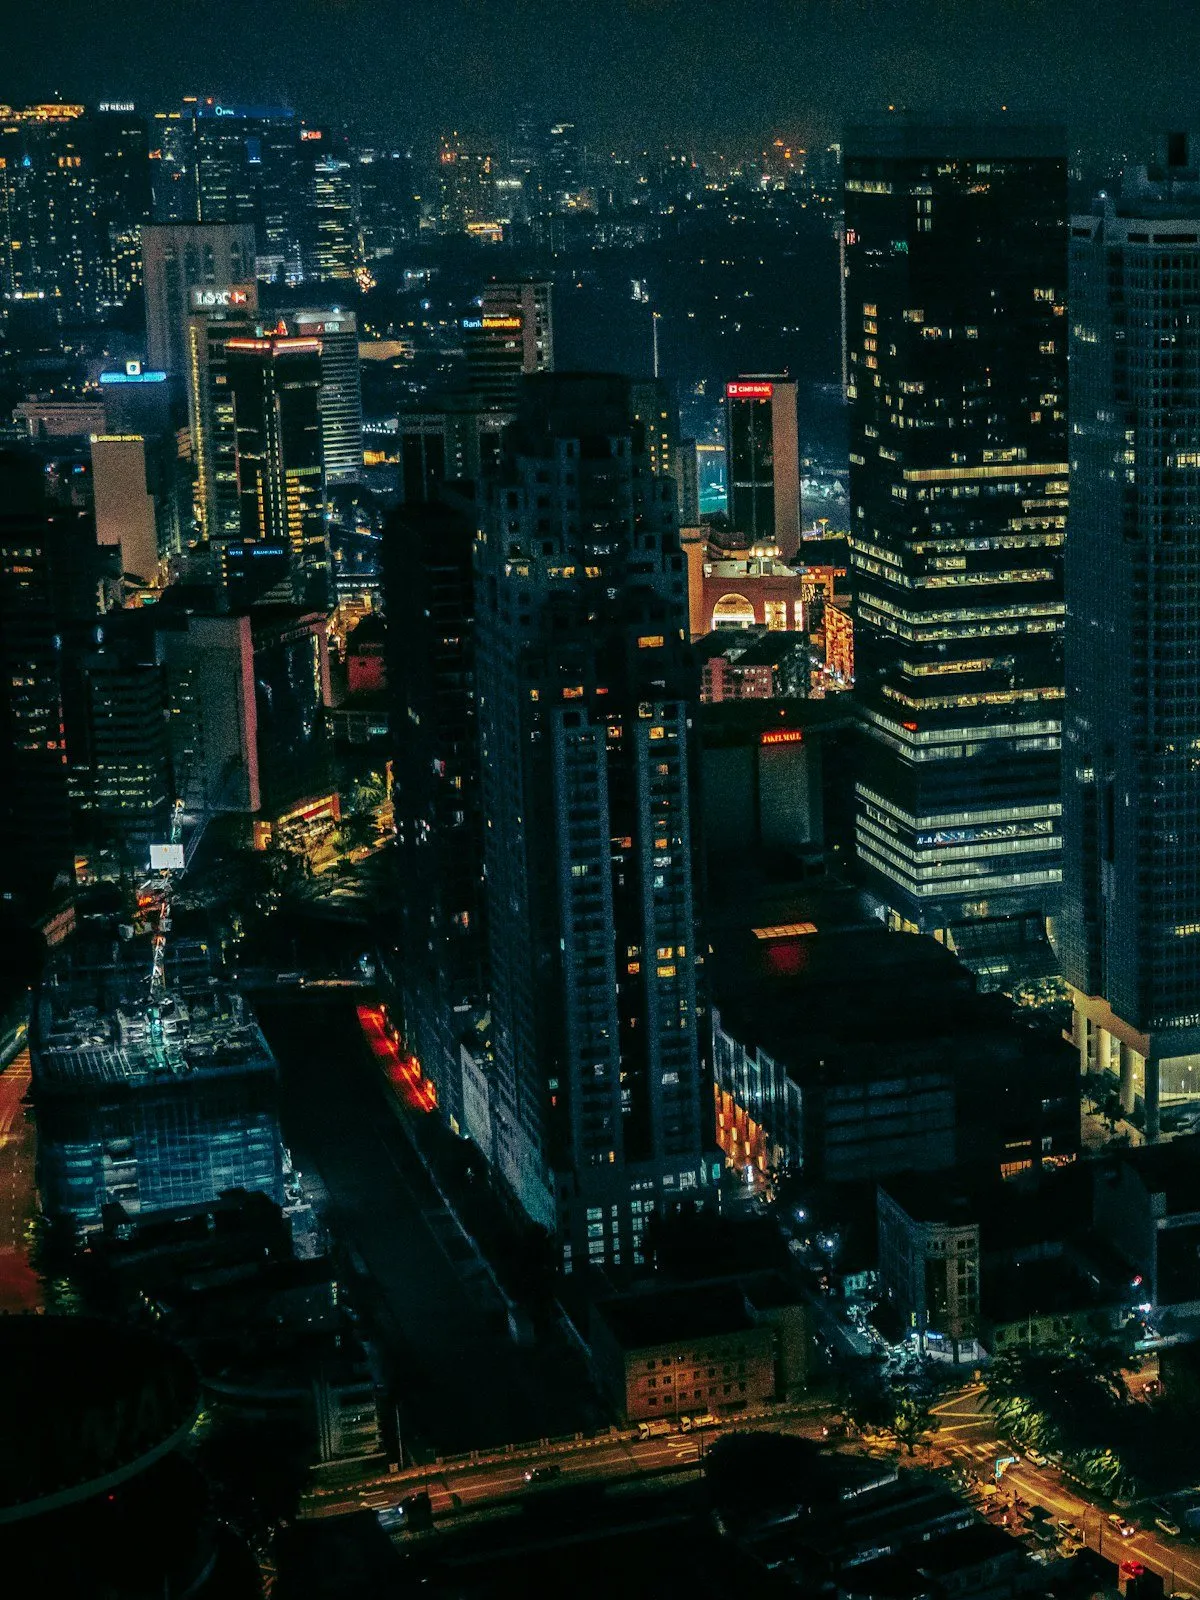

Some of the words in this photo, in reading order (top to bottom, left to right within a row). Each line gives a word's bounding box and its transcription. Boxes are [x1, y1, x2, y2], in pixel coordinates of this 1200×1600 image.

[463, 319, 482, 328] Bank
[754, 385, 770, 393] BANK
[122, 434, 144, 442] HOTEL
[783, 732, 801, 742] MALL
